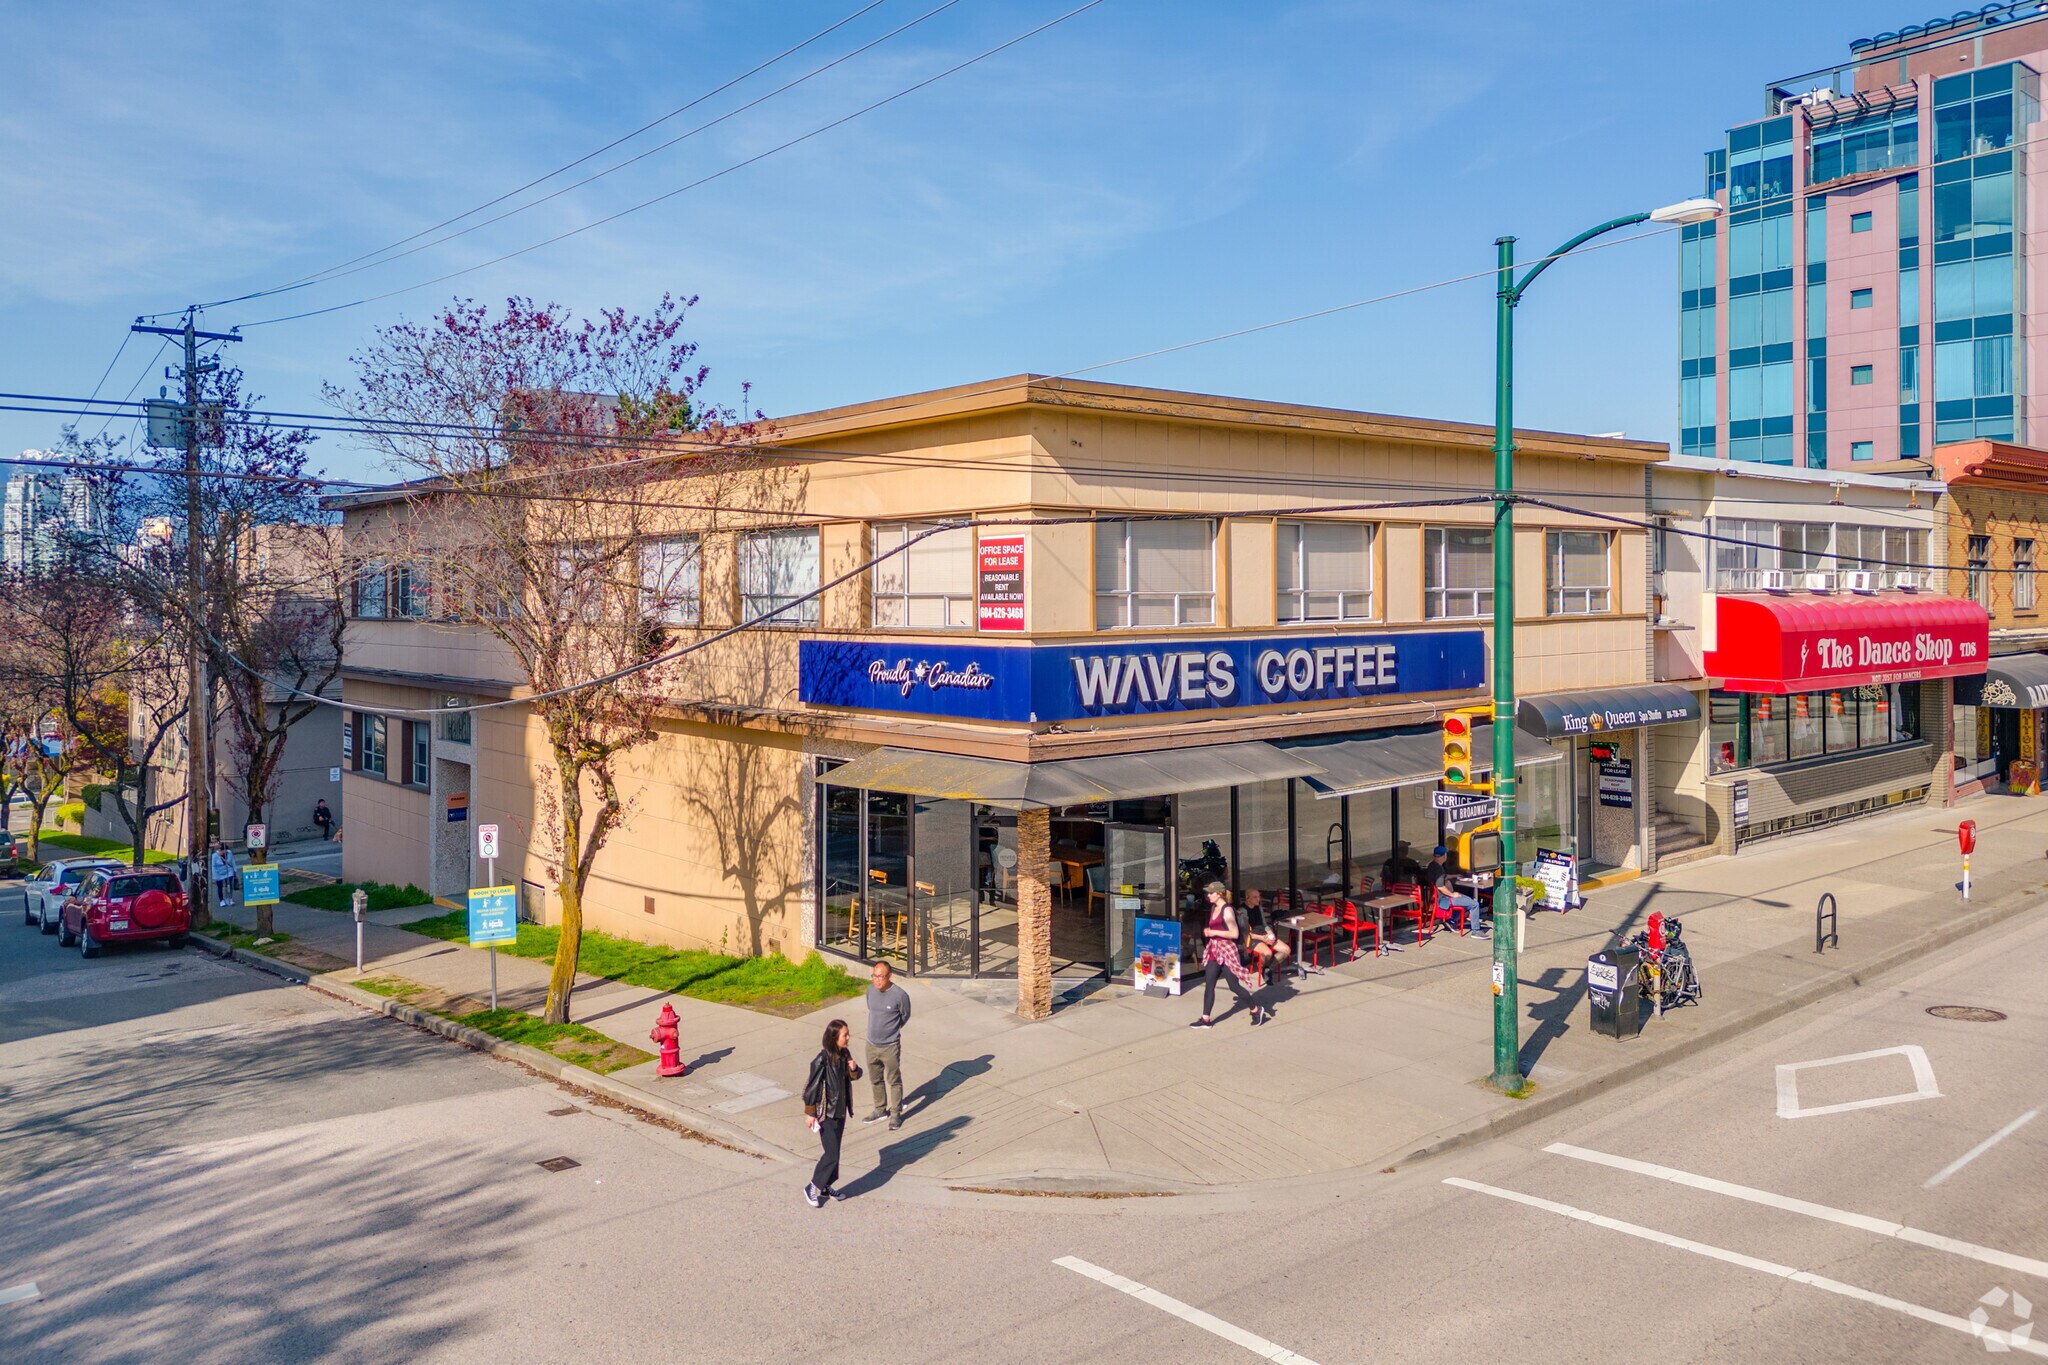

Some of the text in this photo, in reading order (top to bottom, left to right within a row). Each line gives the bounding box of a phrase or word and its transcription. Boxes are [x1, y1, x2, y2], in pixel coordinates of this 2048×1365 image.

[980, 545, 1024, 555] OFFICE SPACE
[984, 557, 1019, 566] FOR LEASE
[984, 574, 1020, 582] REASONABLE
[980, 593, 1024, 601] AVAILABLE NOW!
[980, 607, 1024, 619] 604-626-3468
[1817, 633, 1977, 669] The Dance Shop TDS
[868, 658, 991, 697] Proudly Canadian
[1072, 644, 1397, 706] WAVES COFFEE
[1562, 713, 1588, 733] King
[1605, 710, 1636, 729] Queen
[1639, 711, 1648, 724] Spa
[1460, 804, 1488, 819] BROADWAY
